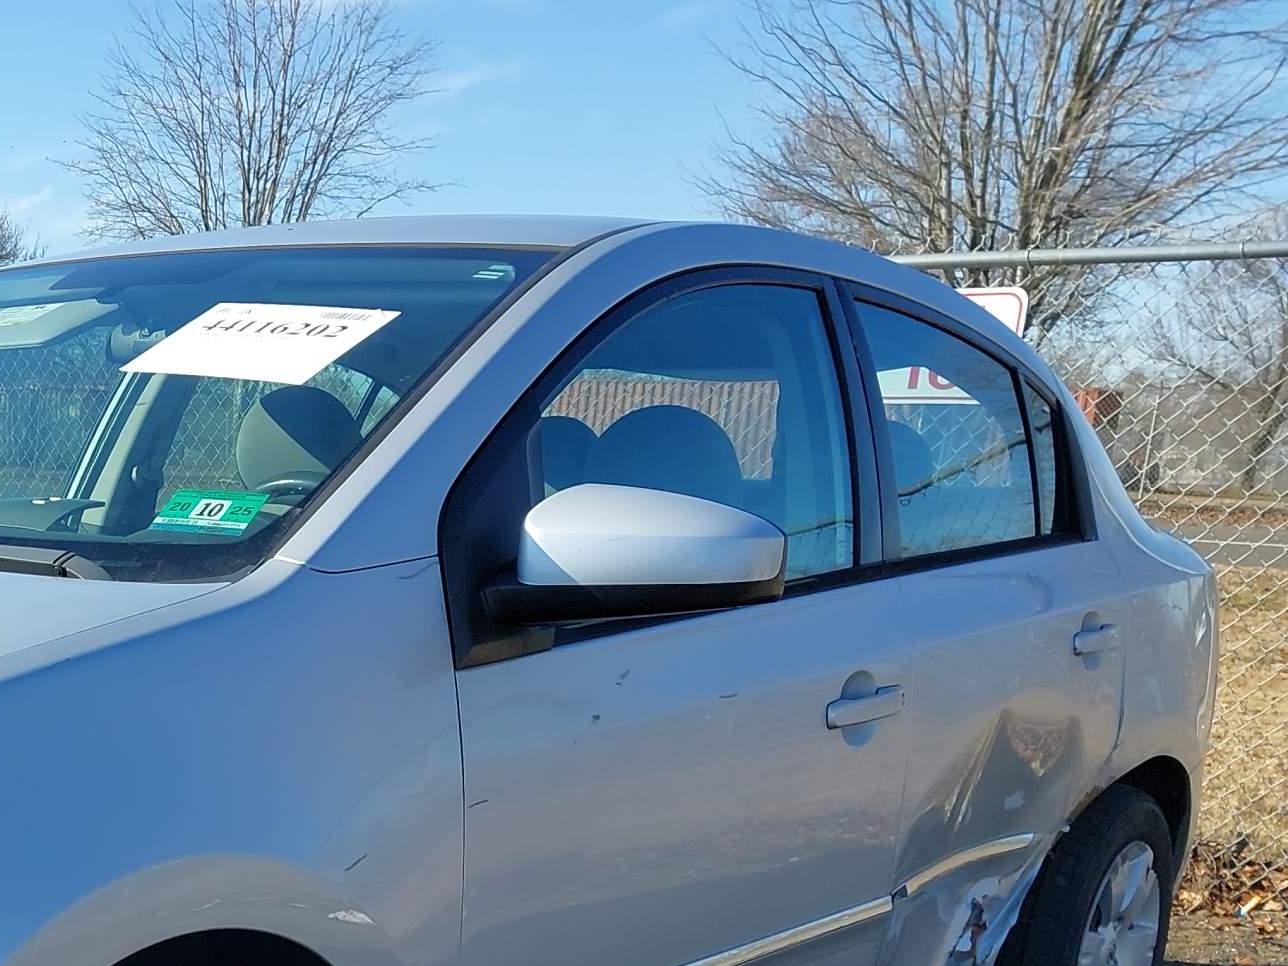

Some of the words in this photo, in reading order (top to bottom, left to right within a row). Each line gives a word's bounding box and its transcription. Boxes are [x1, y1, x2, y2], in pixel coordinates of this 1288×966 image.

[202, 319, 348, 337] 44116202
[168, 502, 192, 512] 20
[195, 502, 225, 518] 10
[229, 506, 254, 516] 25
